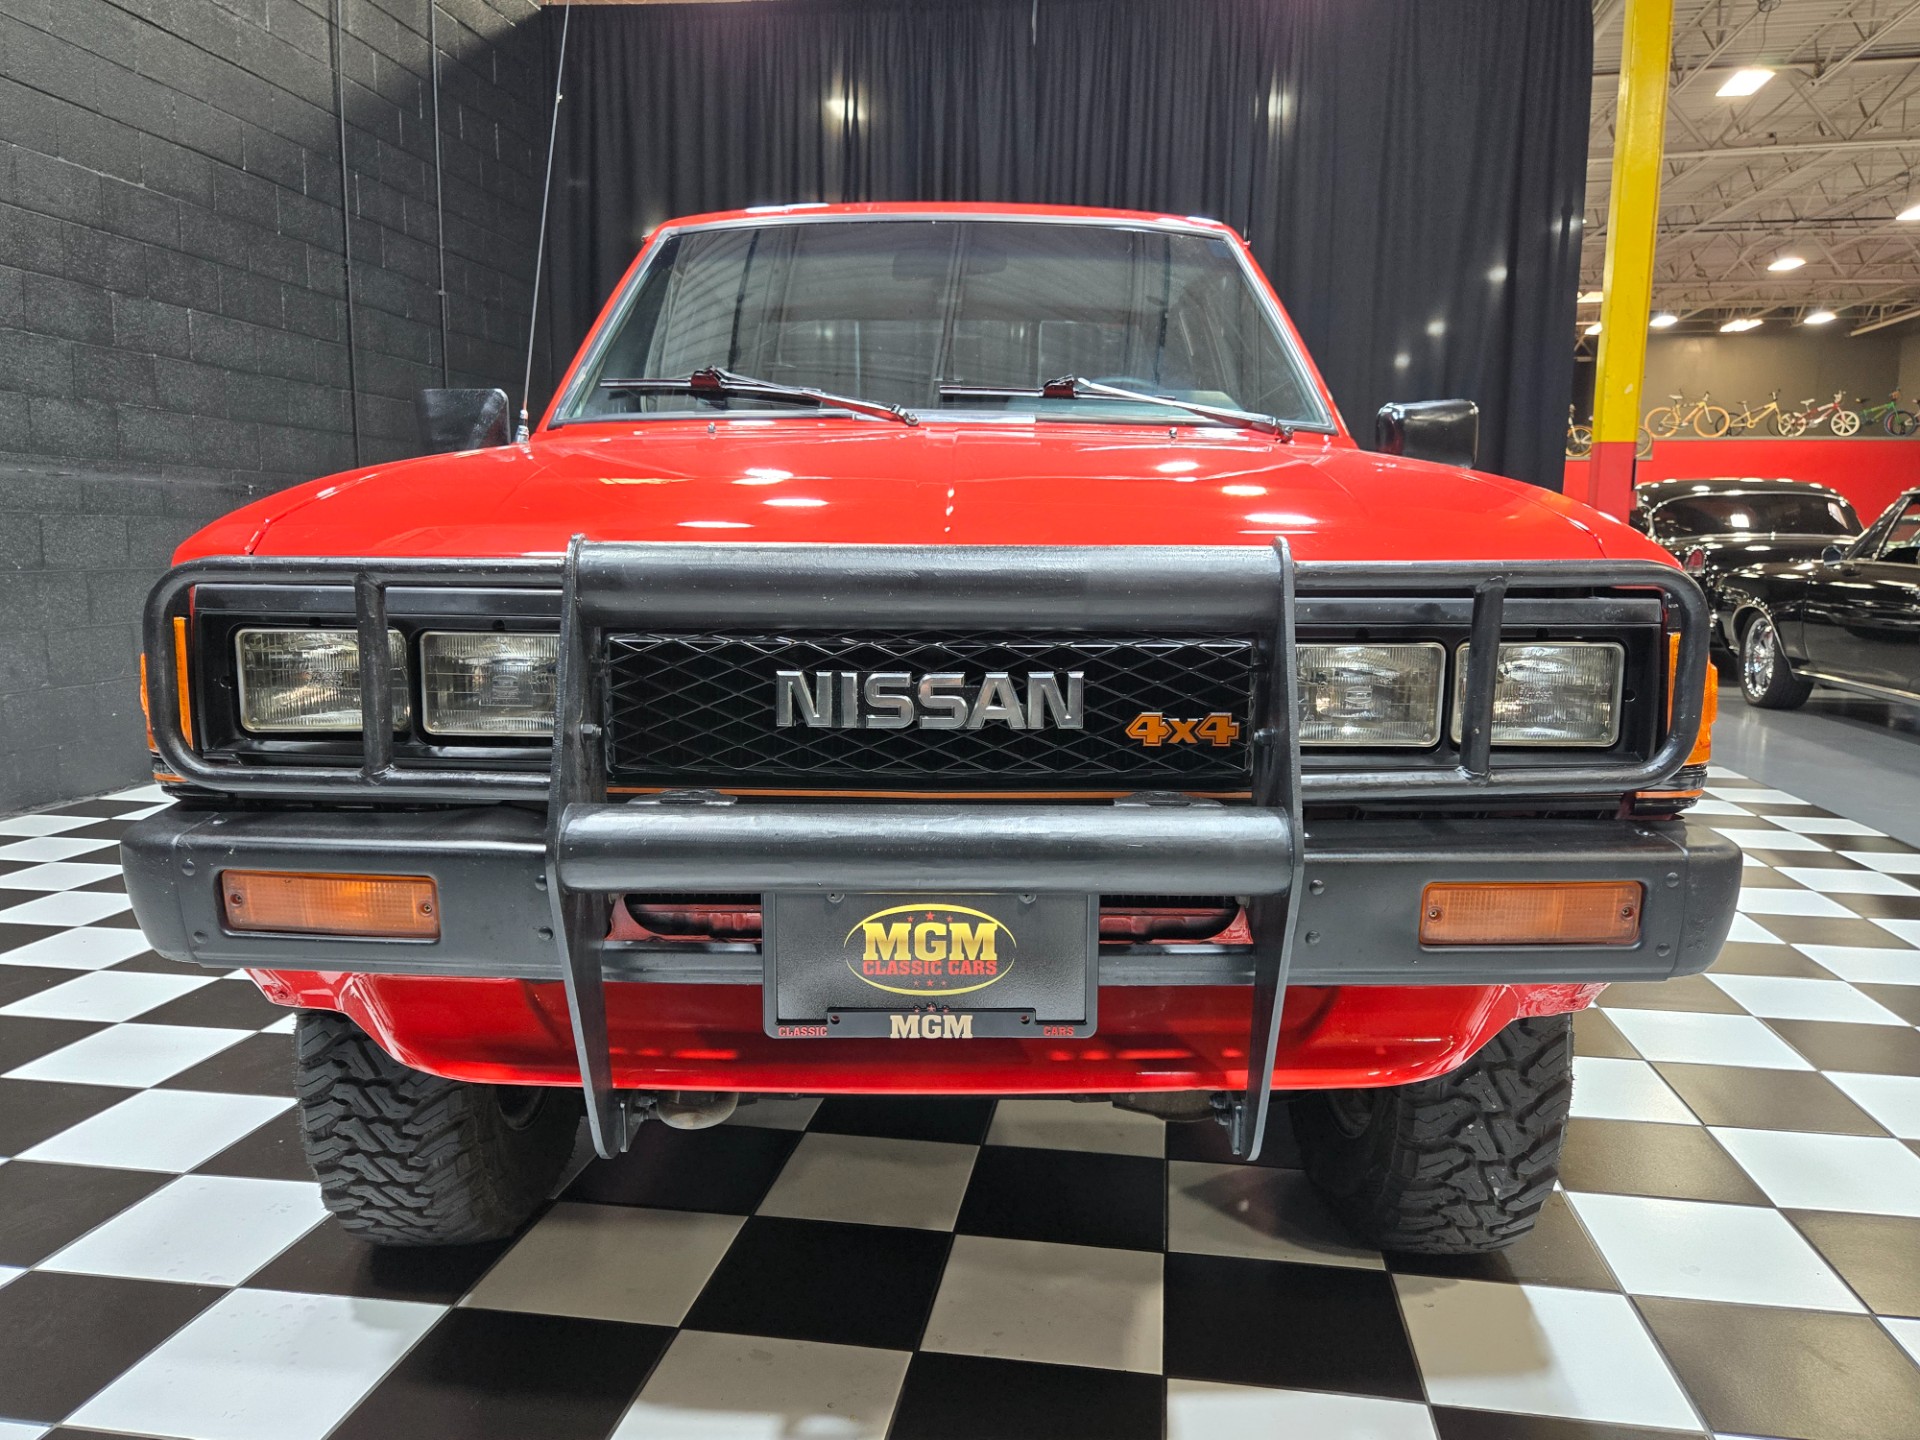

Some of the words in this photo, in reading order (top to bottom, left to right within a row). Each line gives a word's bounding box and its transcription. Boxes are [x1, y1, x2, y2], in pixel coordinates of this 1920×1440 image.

[776, 670, 1085, 729] NISSAN
[1125, 711, 1241, 747] 4x4
[862, 922, 998, 962] MGM
[862, 960, 942, 976] CLASSIC
[947, 960, 997, 976] CARS
[777, 1026, 828, 1037] CLASSIC
[889, 1014, 974, 1039] MGM
[1043, 1026, 1075, 1037] CARS
